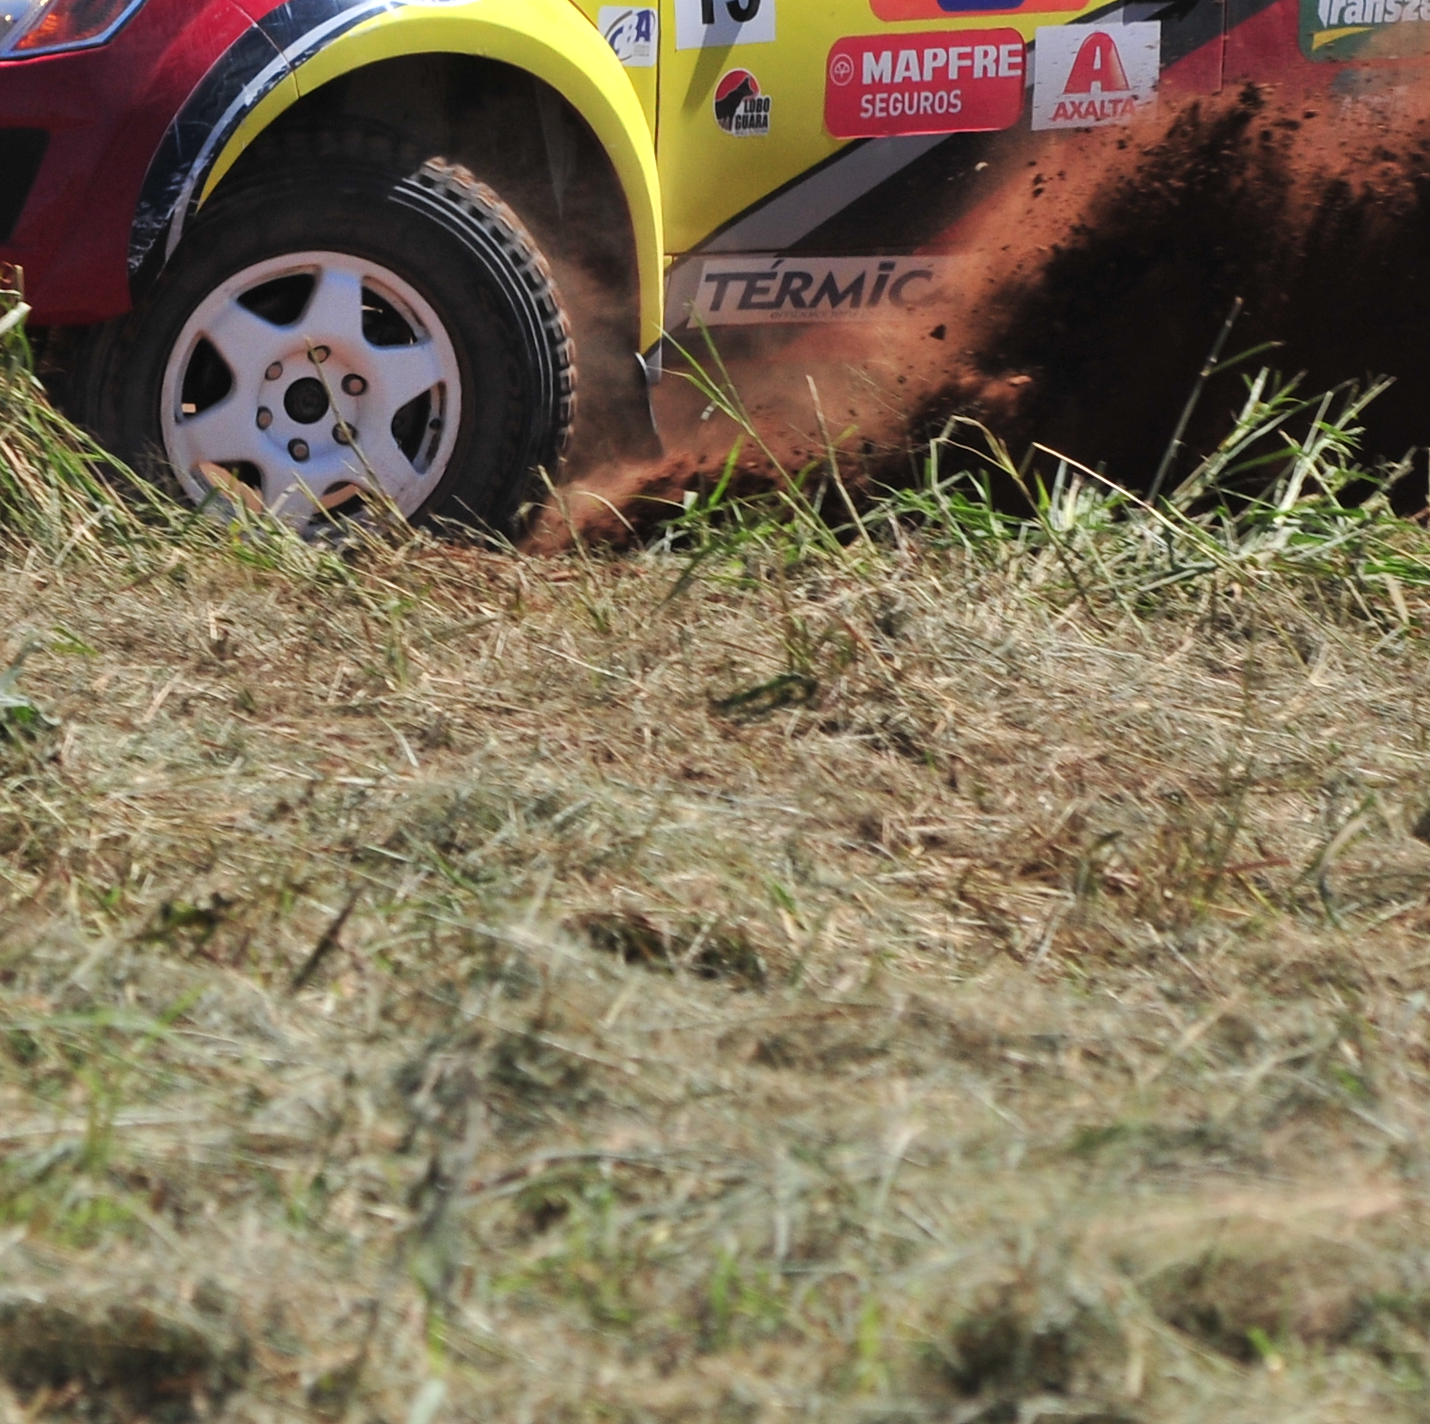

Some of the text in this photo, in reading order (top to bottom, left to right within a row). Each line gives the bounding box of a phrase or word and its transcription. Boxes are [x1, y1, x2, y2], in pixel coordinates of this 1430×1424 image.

[862, 43, 1023, 85] MAPFRE
[743, 97, 770, 114] LOBO
[860, 89, 962, 119] SEGUROS
[1052, 97, 1139, 122] AXALTA
[704, 258, 934, 312] TÉRMIC
